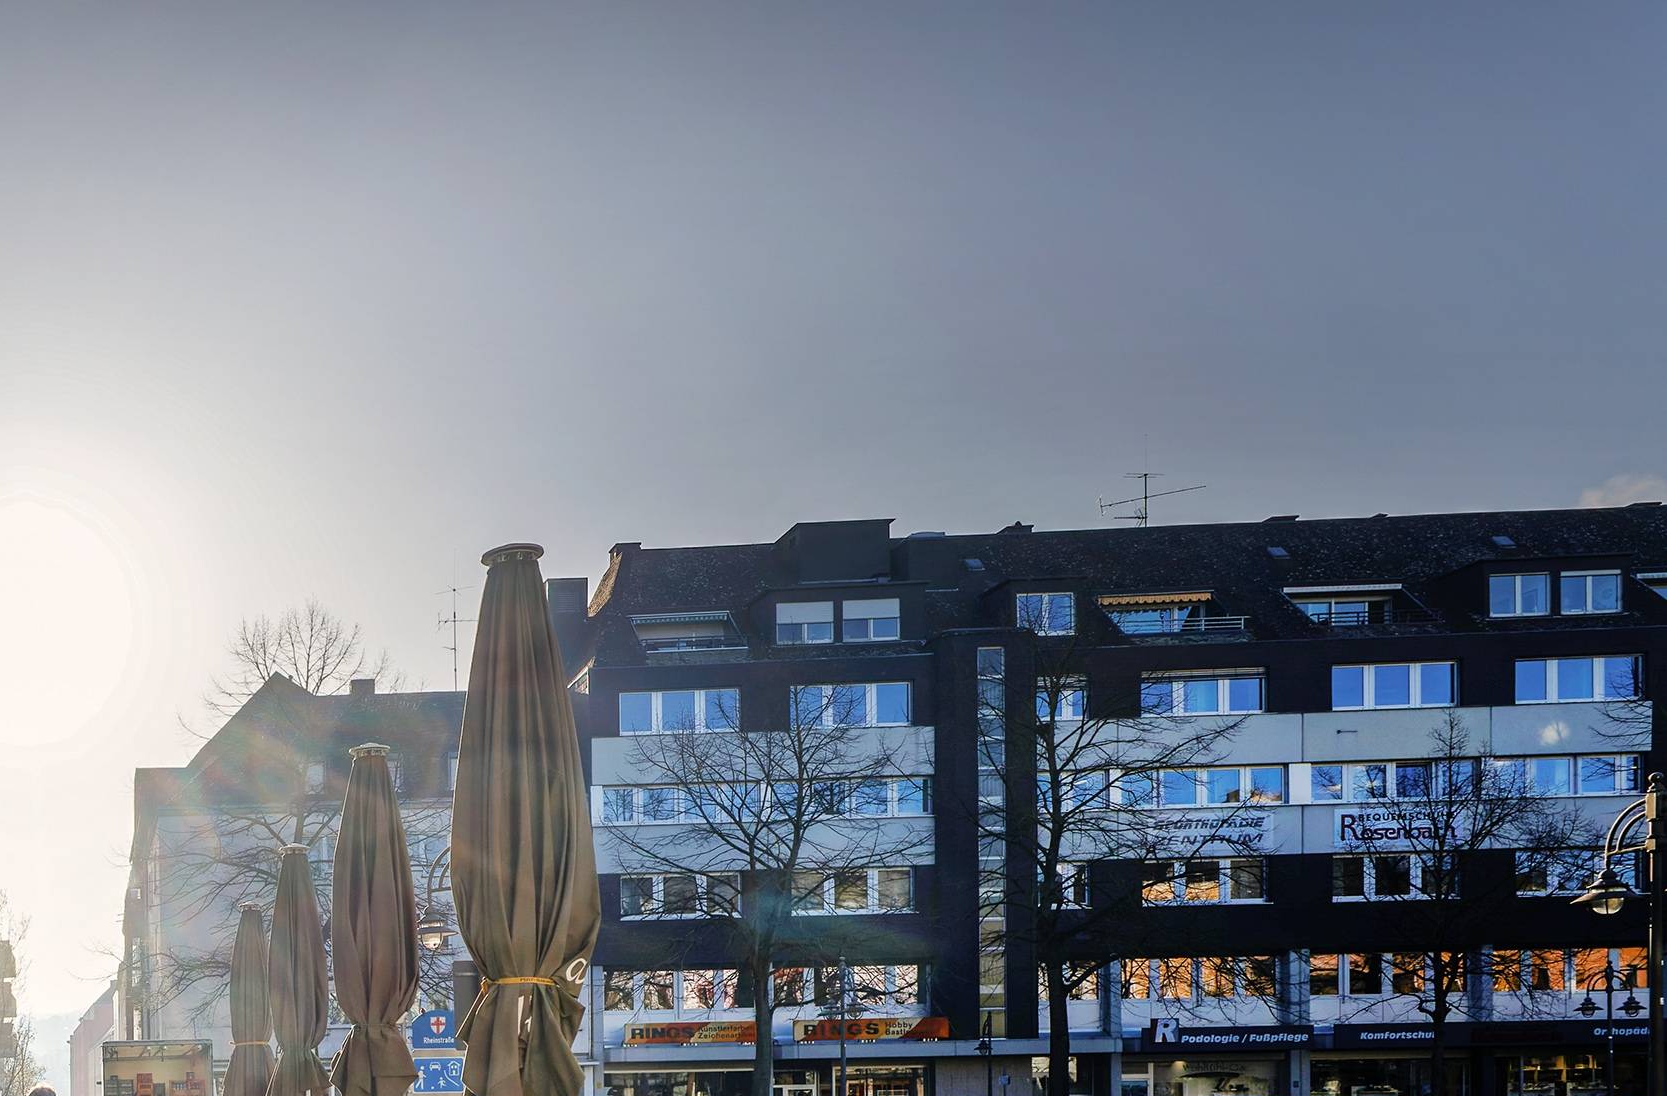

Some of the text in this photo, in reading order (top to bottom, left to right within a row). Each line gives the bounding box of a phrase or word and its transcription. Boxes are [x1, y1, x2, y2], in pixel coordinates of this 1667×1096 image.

[803, 1023, 880, 1036] RINGS
[885, 1021, 914, 1031] Hobby
[1155, 1019, 1176, 1043] R
[1593, 1026, 1651, 1037] Orhopäd
[631, 1026, 696, 1039] RINGS
[1181, 1034, 1240, 1044] Podologie
[1249, 1033, 1309, 1043] Fußpflege
